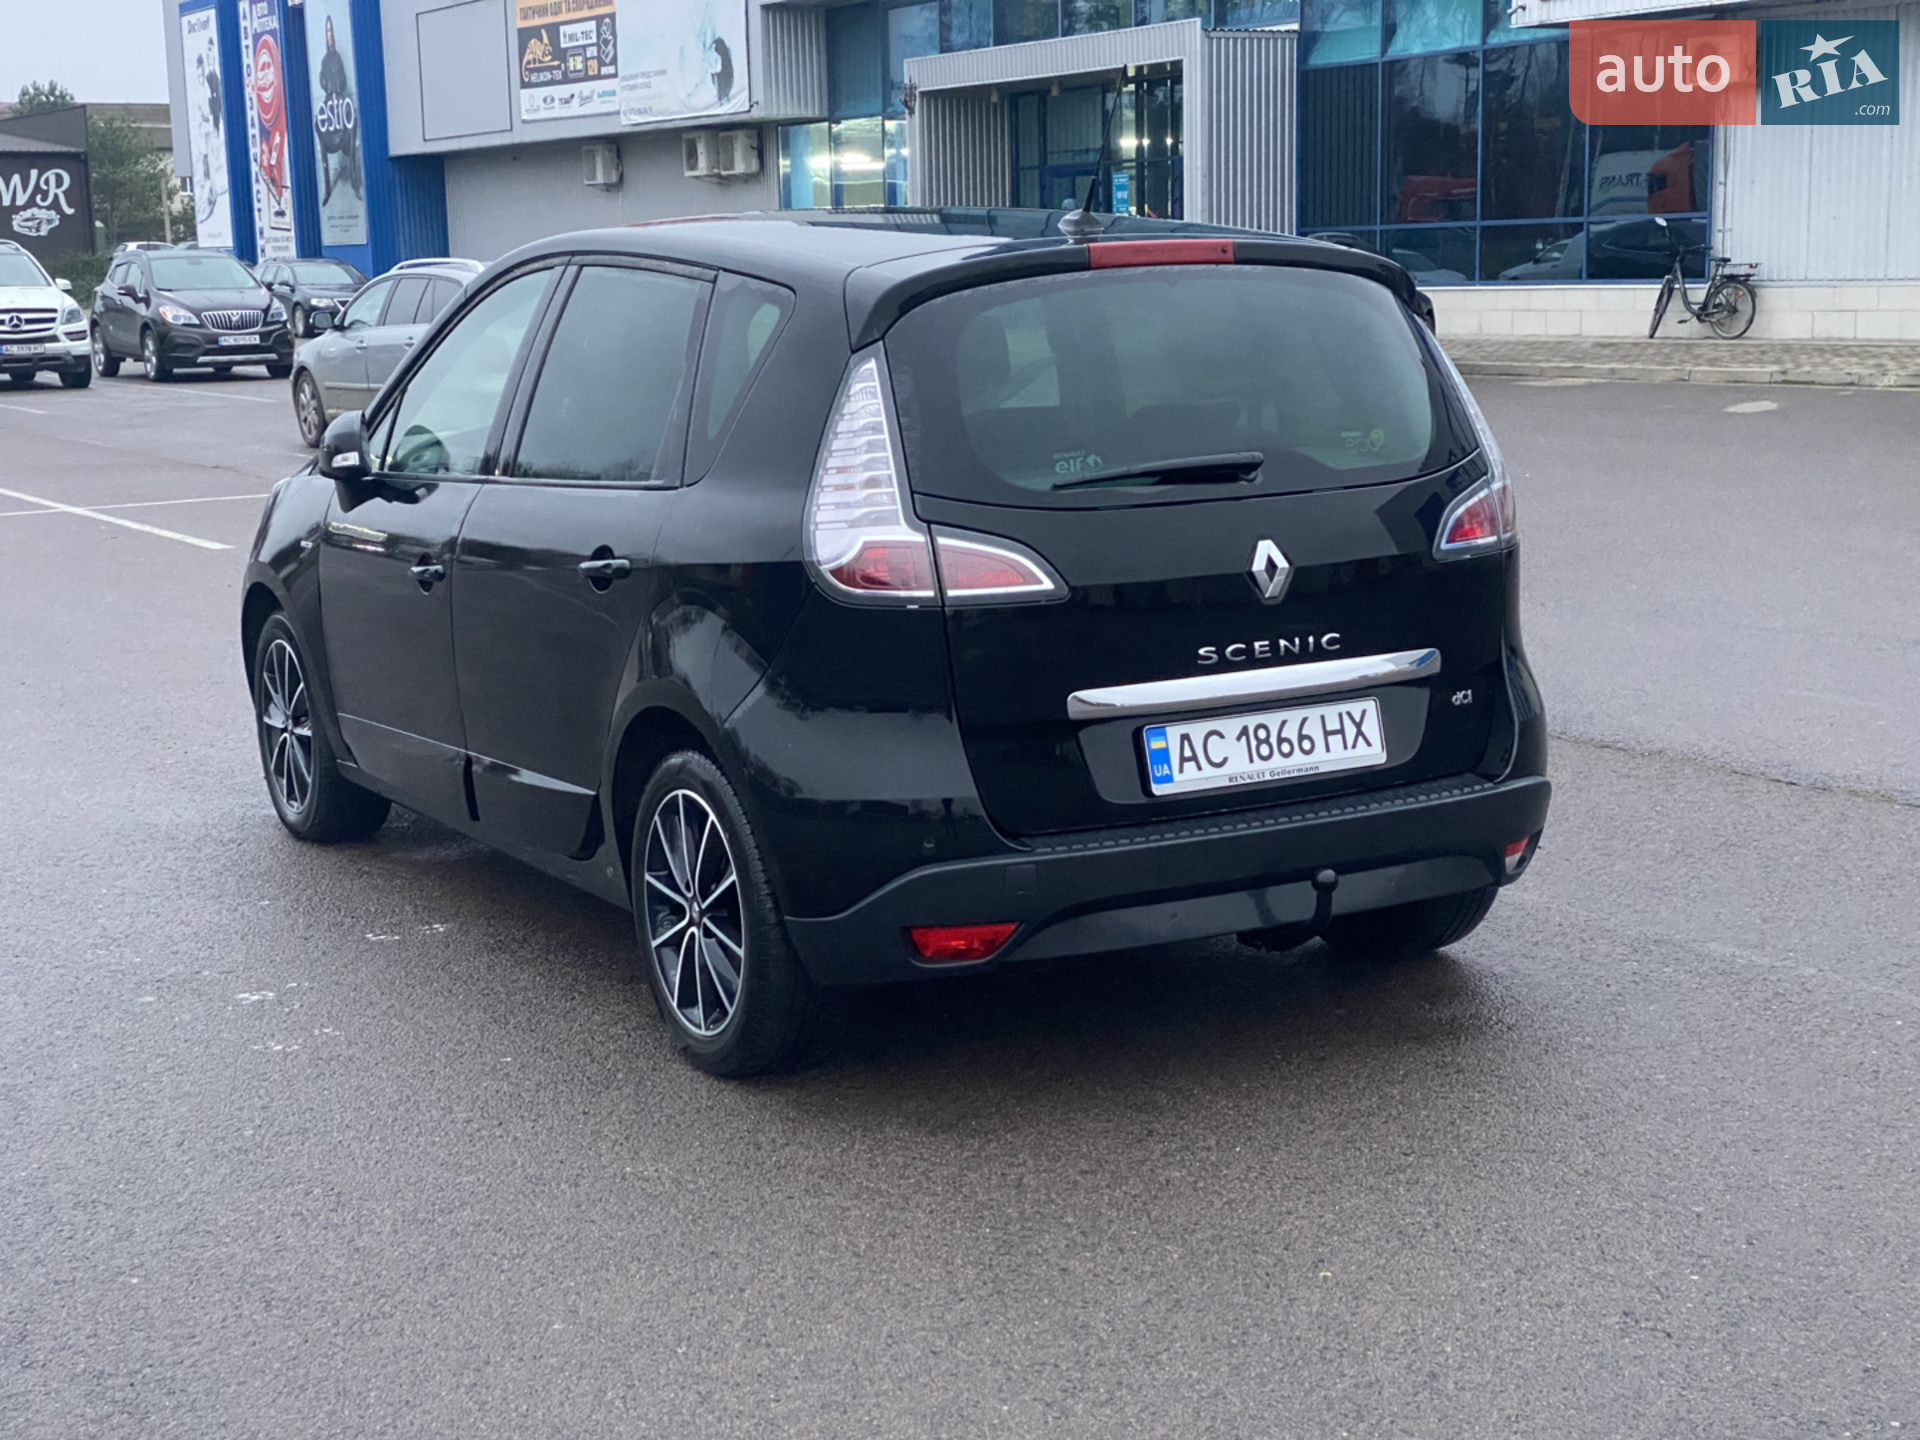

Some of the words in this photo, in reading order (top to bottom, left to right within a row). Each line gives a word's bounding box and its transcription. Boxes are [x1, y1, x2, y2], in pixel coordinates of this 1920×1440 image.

[317, 93, 355, 132] estro
[1055, 457, 1084, 474] elf
[1197, 632, 1341, 665] SCENIC
[1178, 728, 1229, 775] AC
[1235, 715, 1316, 765] 1866
[1319, 708, 1373, 754] HX
[1153, 764, 1171, 778] UA
[1227, 770, 1267, 784] RENAULT
[1269, 764, 1320, 778] Gellermann
